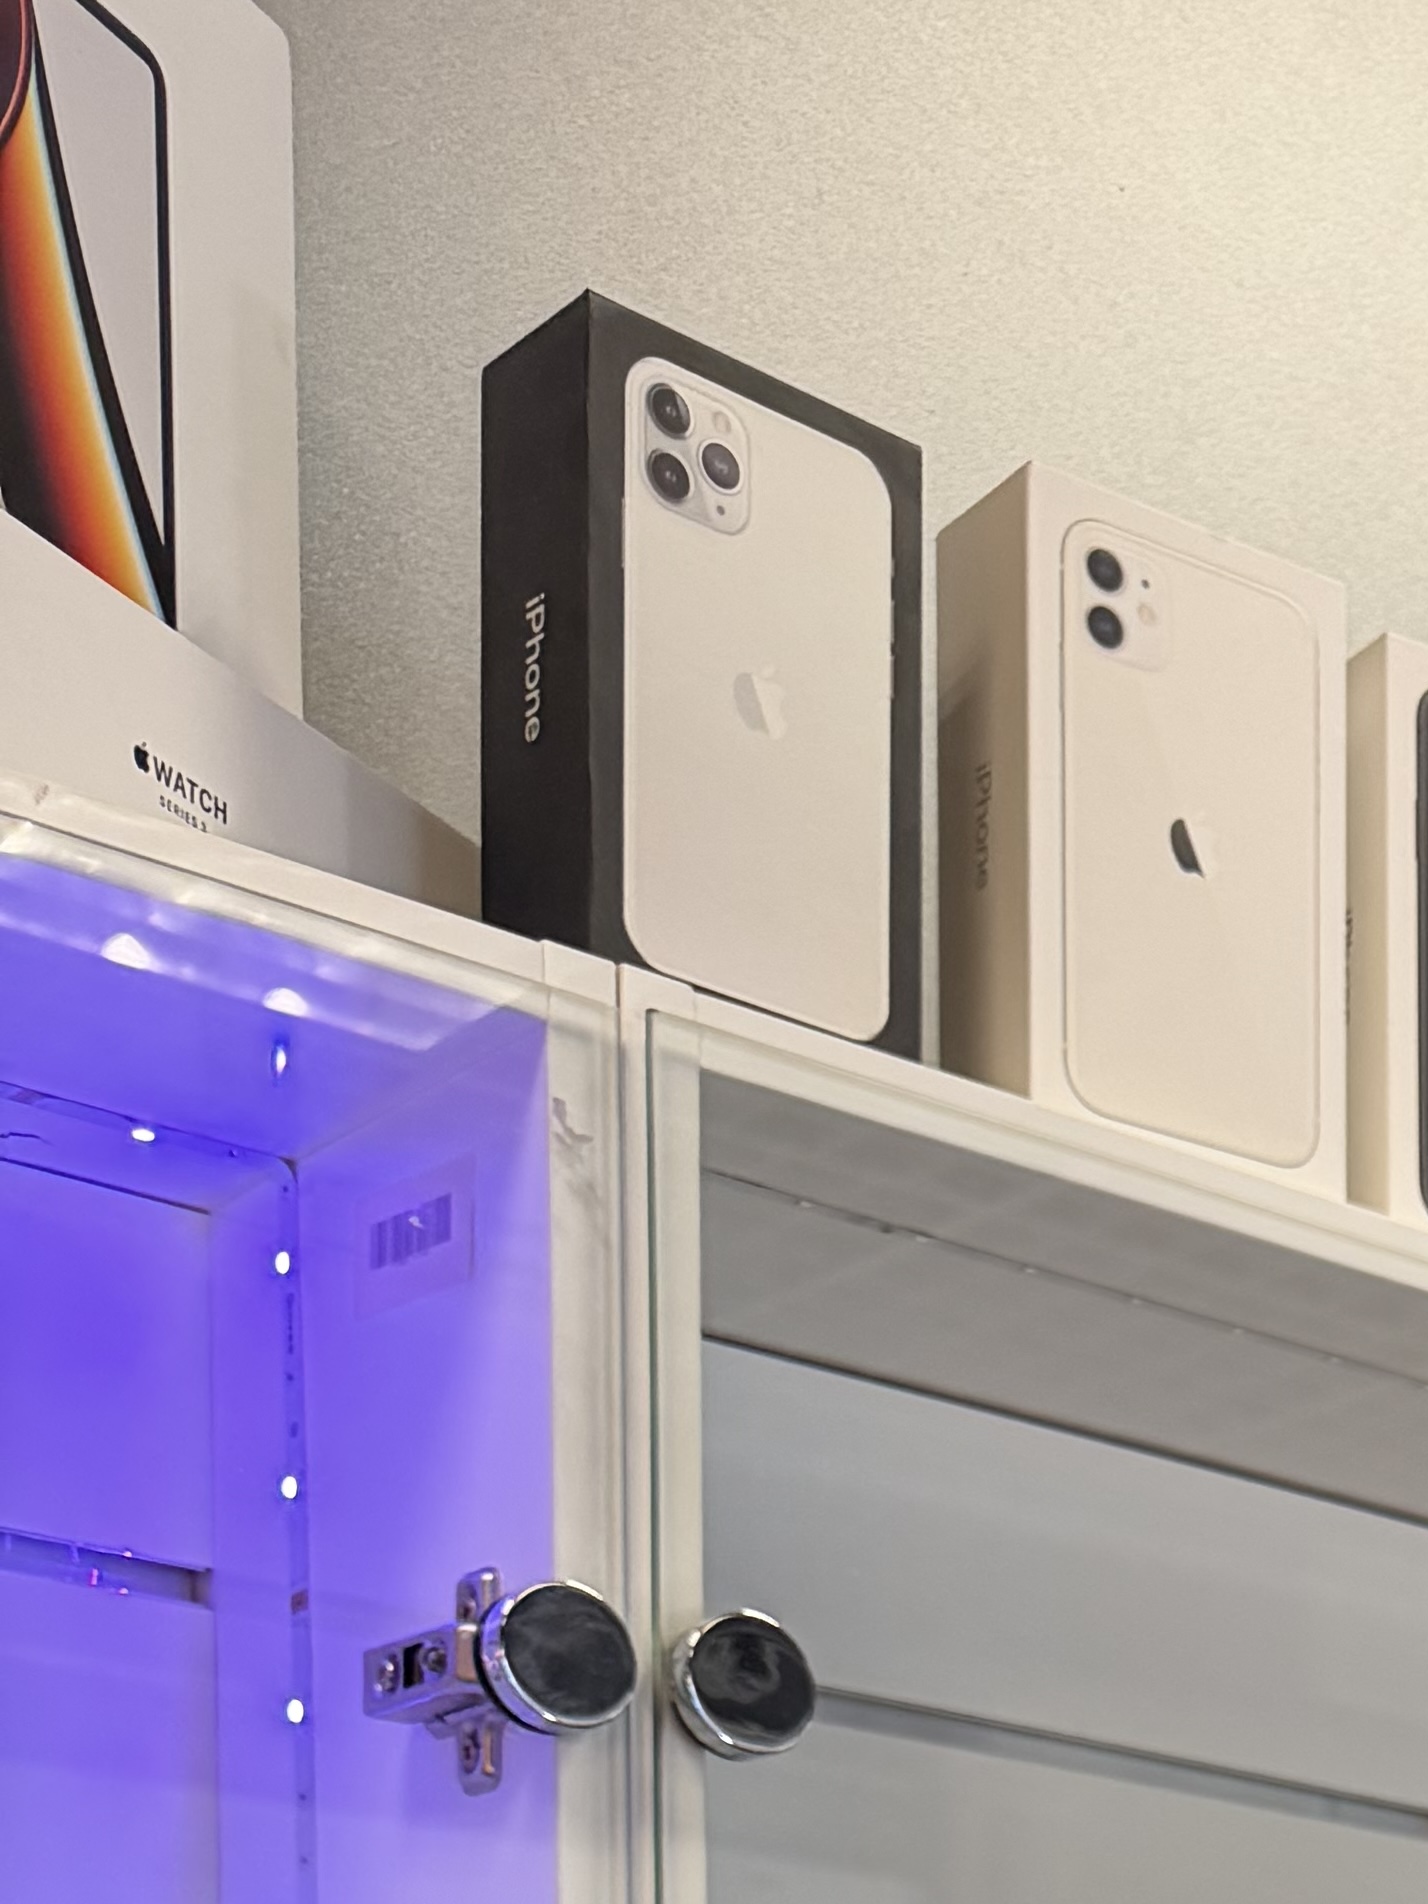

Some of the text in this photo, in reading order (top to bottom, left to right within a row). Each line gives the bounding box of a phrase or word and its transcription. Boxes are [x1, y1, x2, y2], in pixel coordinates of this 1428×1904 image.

[525, 592, 546, 743] iPhone
[153, 755, 227, 825] WATCH
[976, 761, 992, 891] iPhone
